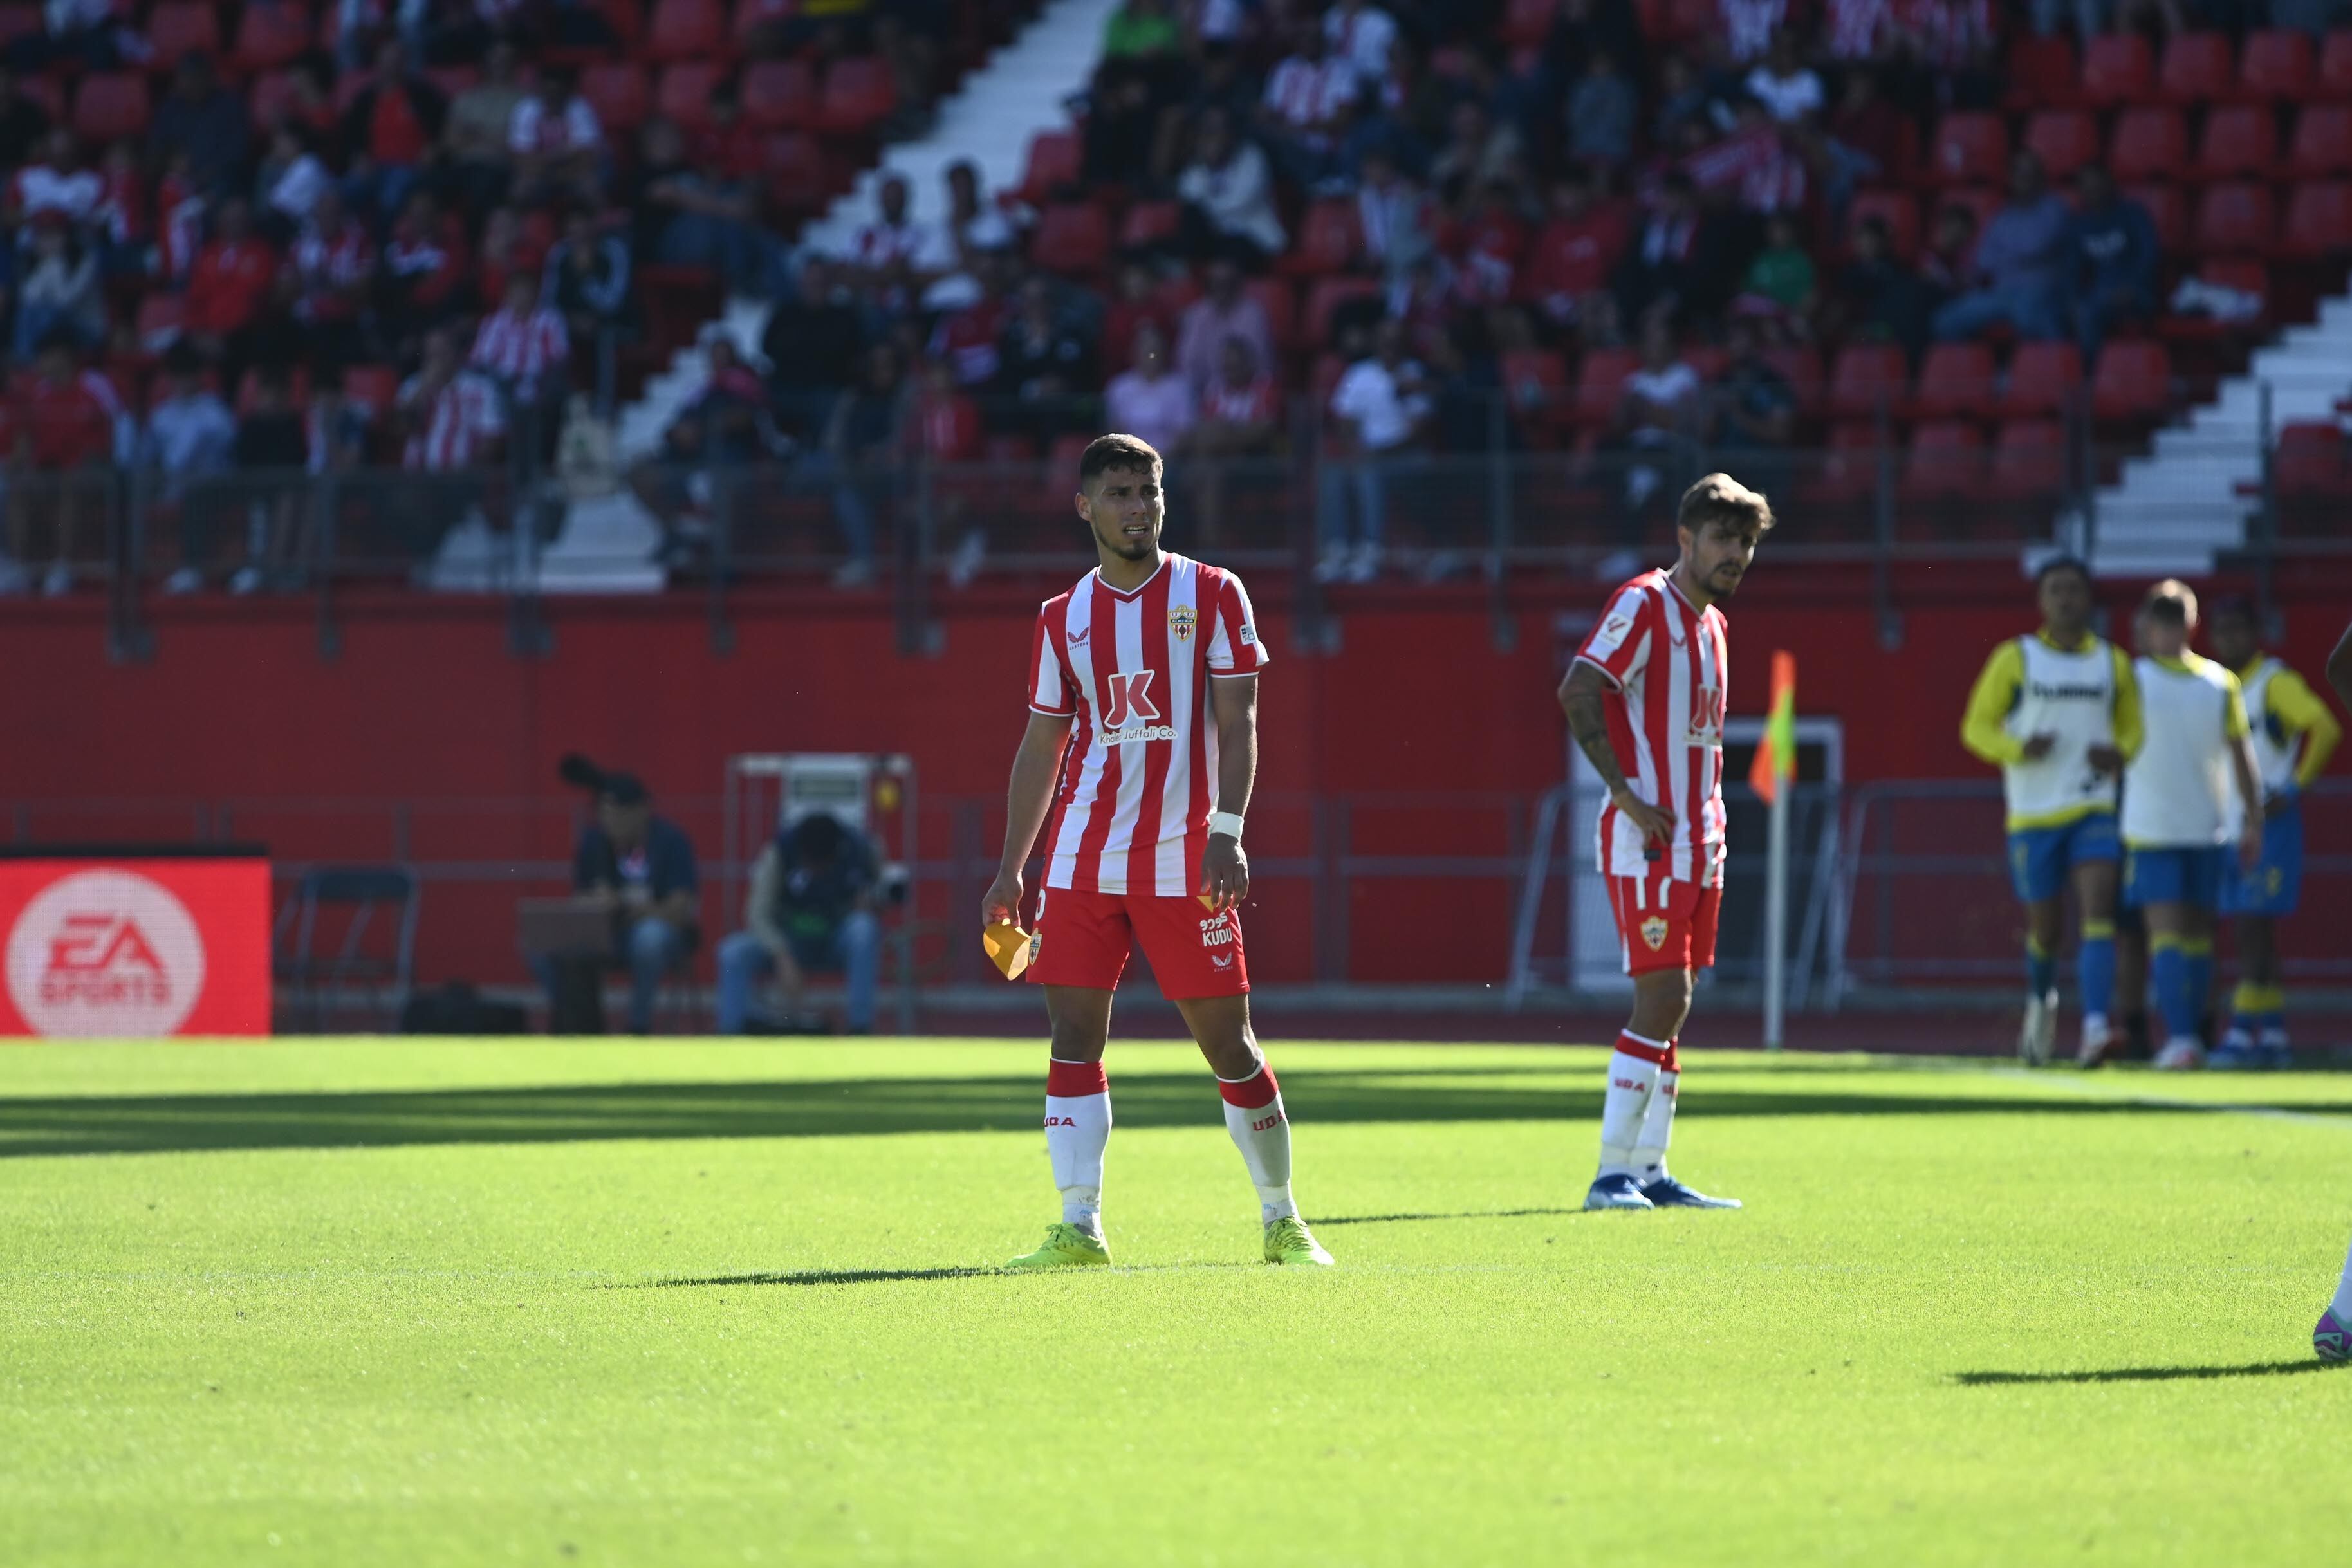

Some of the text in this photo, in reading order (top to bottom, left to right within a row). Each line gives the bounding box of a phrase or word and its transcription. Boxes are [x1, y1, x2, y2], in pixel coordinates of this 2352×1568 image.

[1106, 671, 1159, 728] JK
[1124, 728, 1155, 739] Juffali
[1159, 728, 1176, 737] Co.
[49, 912, 163, 970] EA
[1202, 928, 1233, 946] KUDU
[39, 974, 171, 1005] SPORTS
